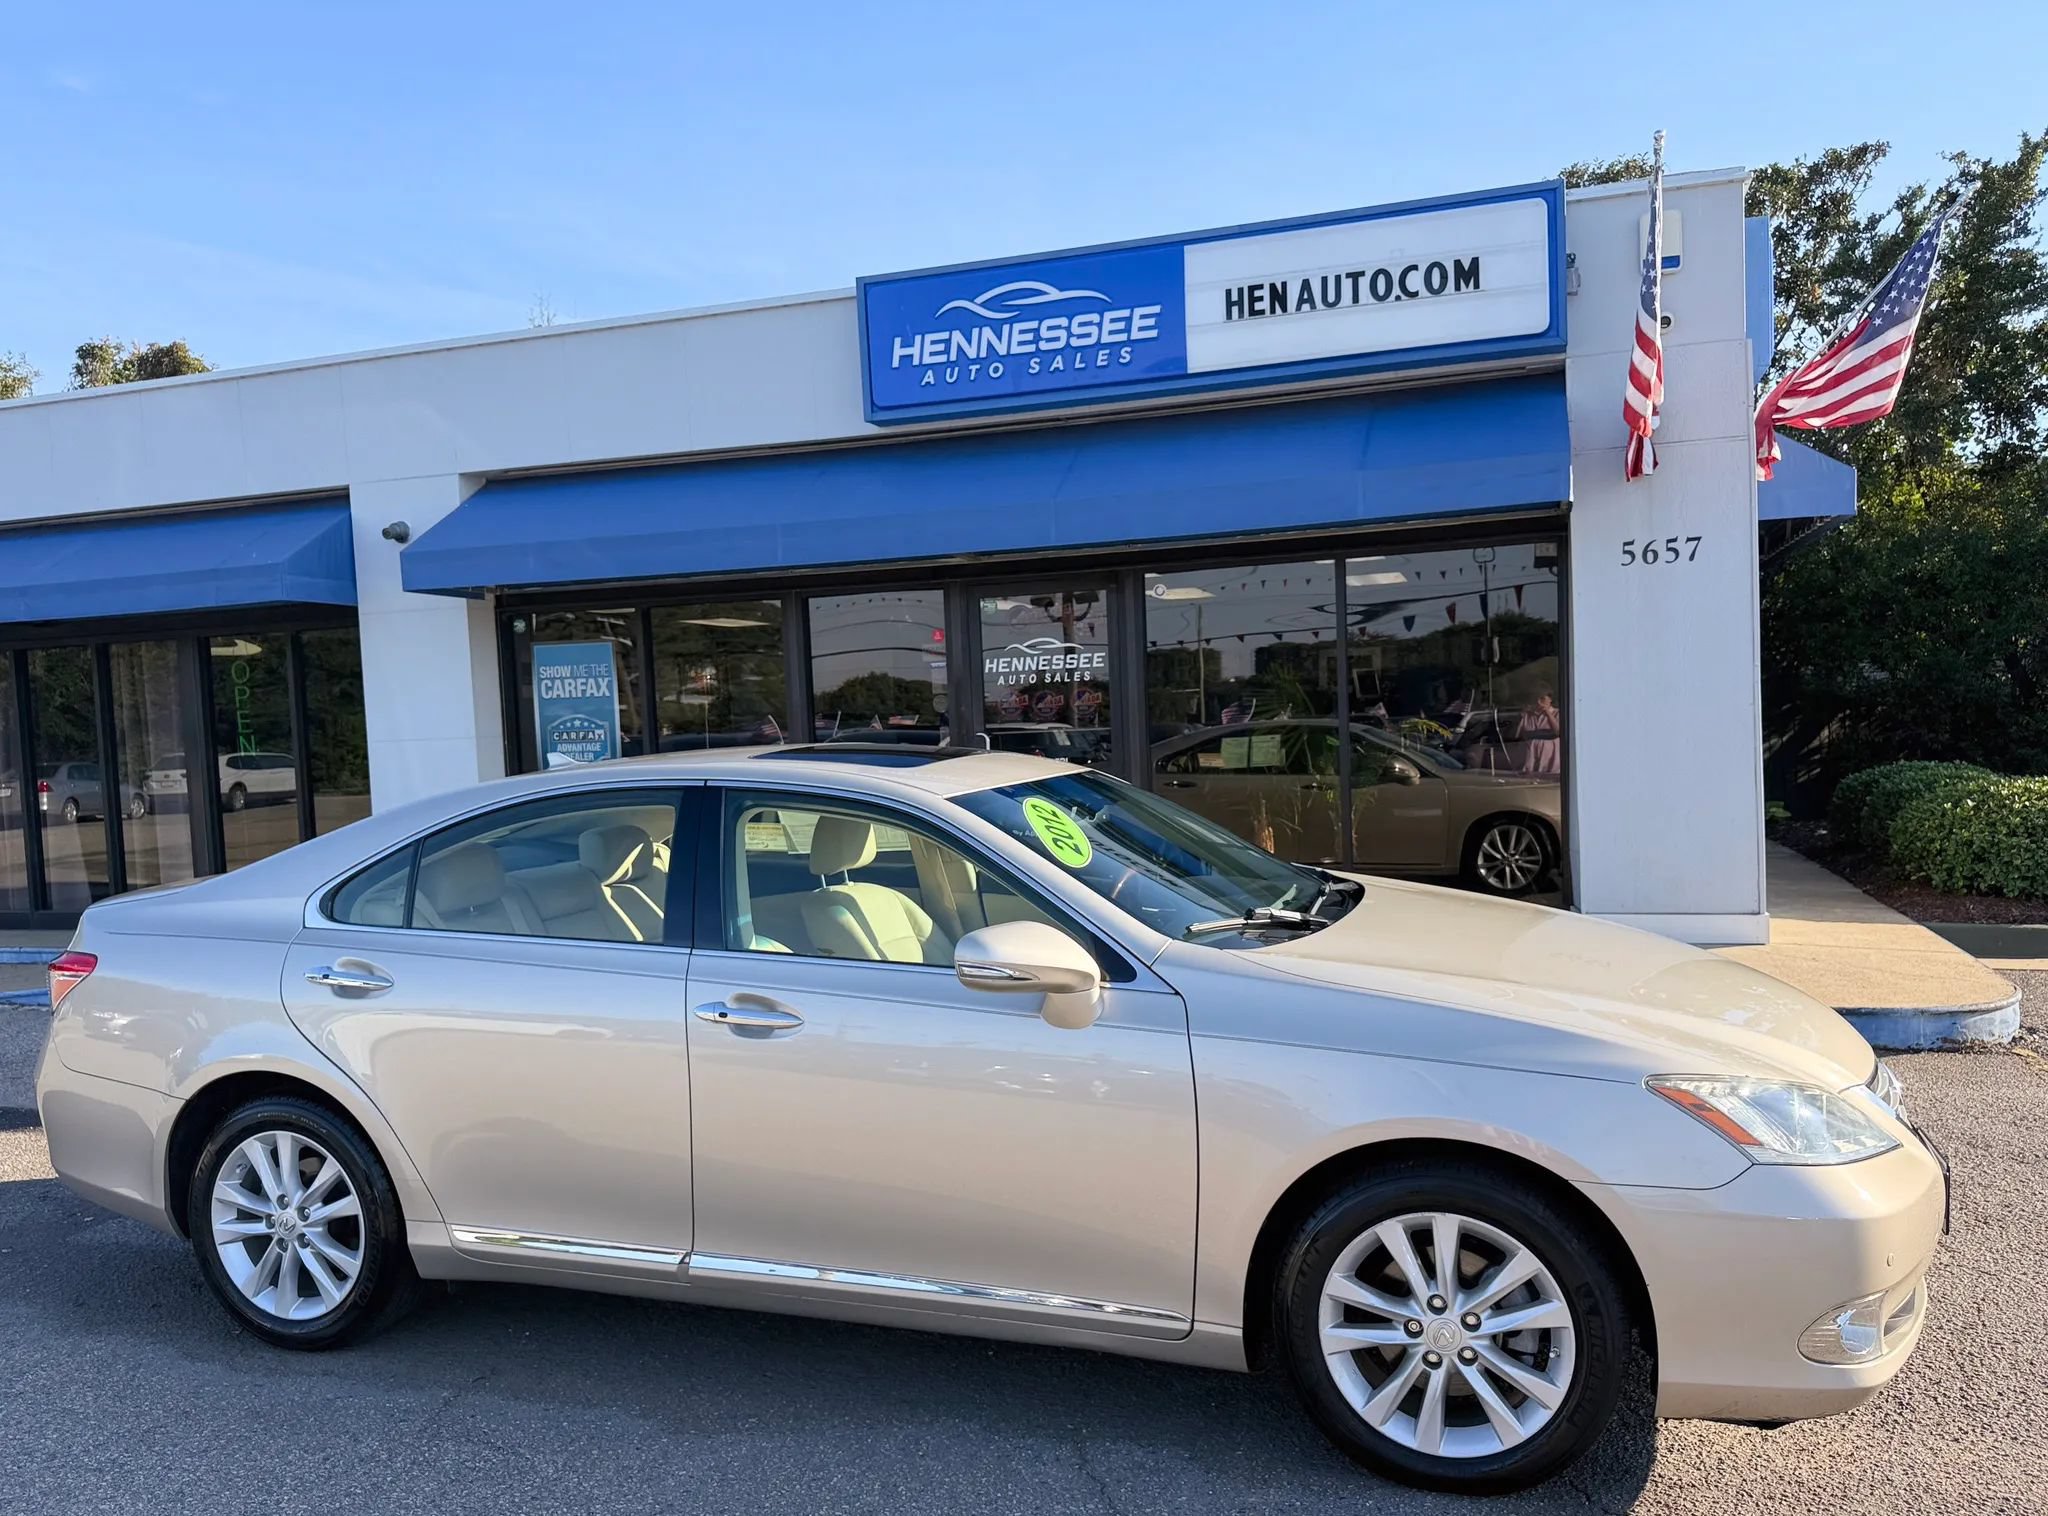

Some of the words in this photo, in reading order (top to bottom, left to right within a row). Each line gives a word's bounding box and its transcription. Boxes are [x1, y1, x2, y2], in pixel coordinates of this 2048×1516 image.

[891, 304, 1162, 369] HENNESSEE
[921, 362, 1004, 386] AUTO
[1029, 347, 1134, 375] SALES
[1621, 536, 1702, 566] 5657
[540, 666, 571, 678] SHOW
[574, 665, 588, 677] ME
[592, 664, 609, 676] THE
[985, 653, 1106, 672] HENNESSEE
[997, 674, 1037, 685] AUTO
[1044, 671, 1091, 683] SALES
[541, 679, 611, 699] CARFAX
[232, 661, 256, 756] OPEN
[553, 730, 604, 740] CARFAX
[557, 742, 601, 752] ADVANTAGE
[1031, 803, 1084, 857] 2012
